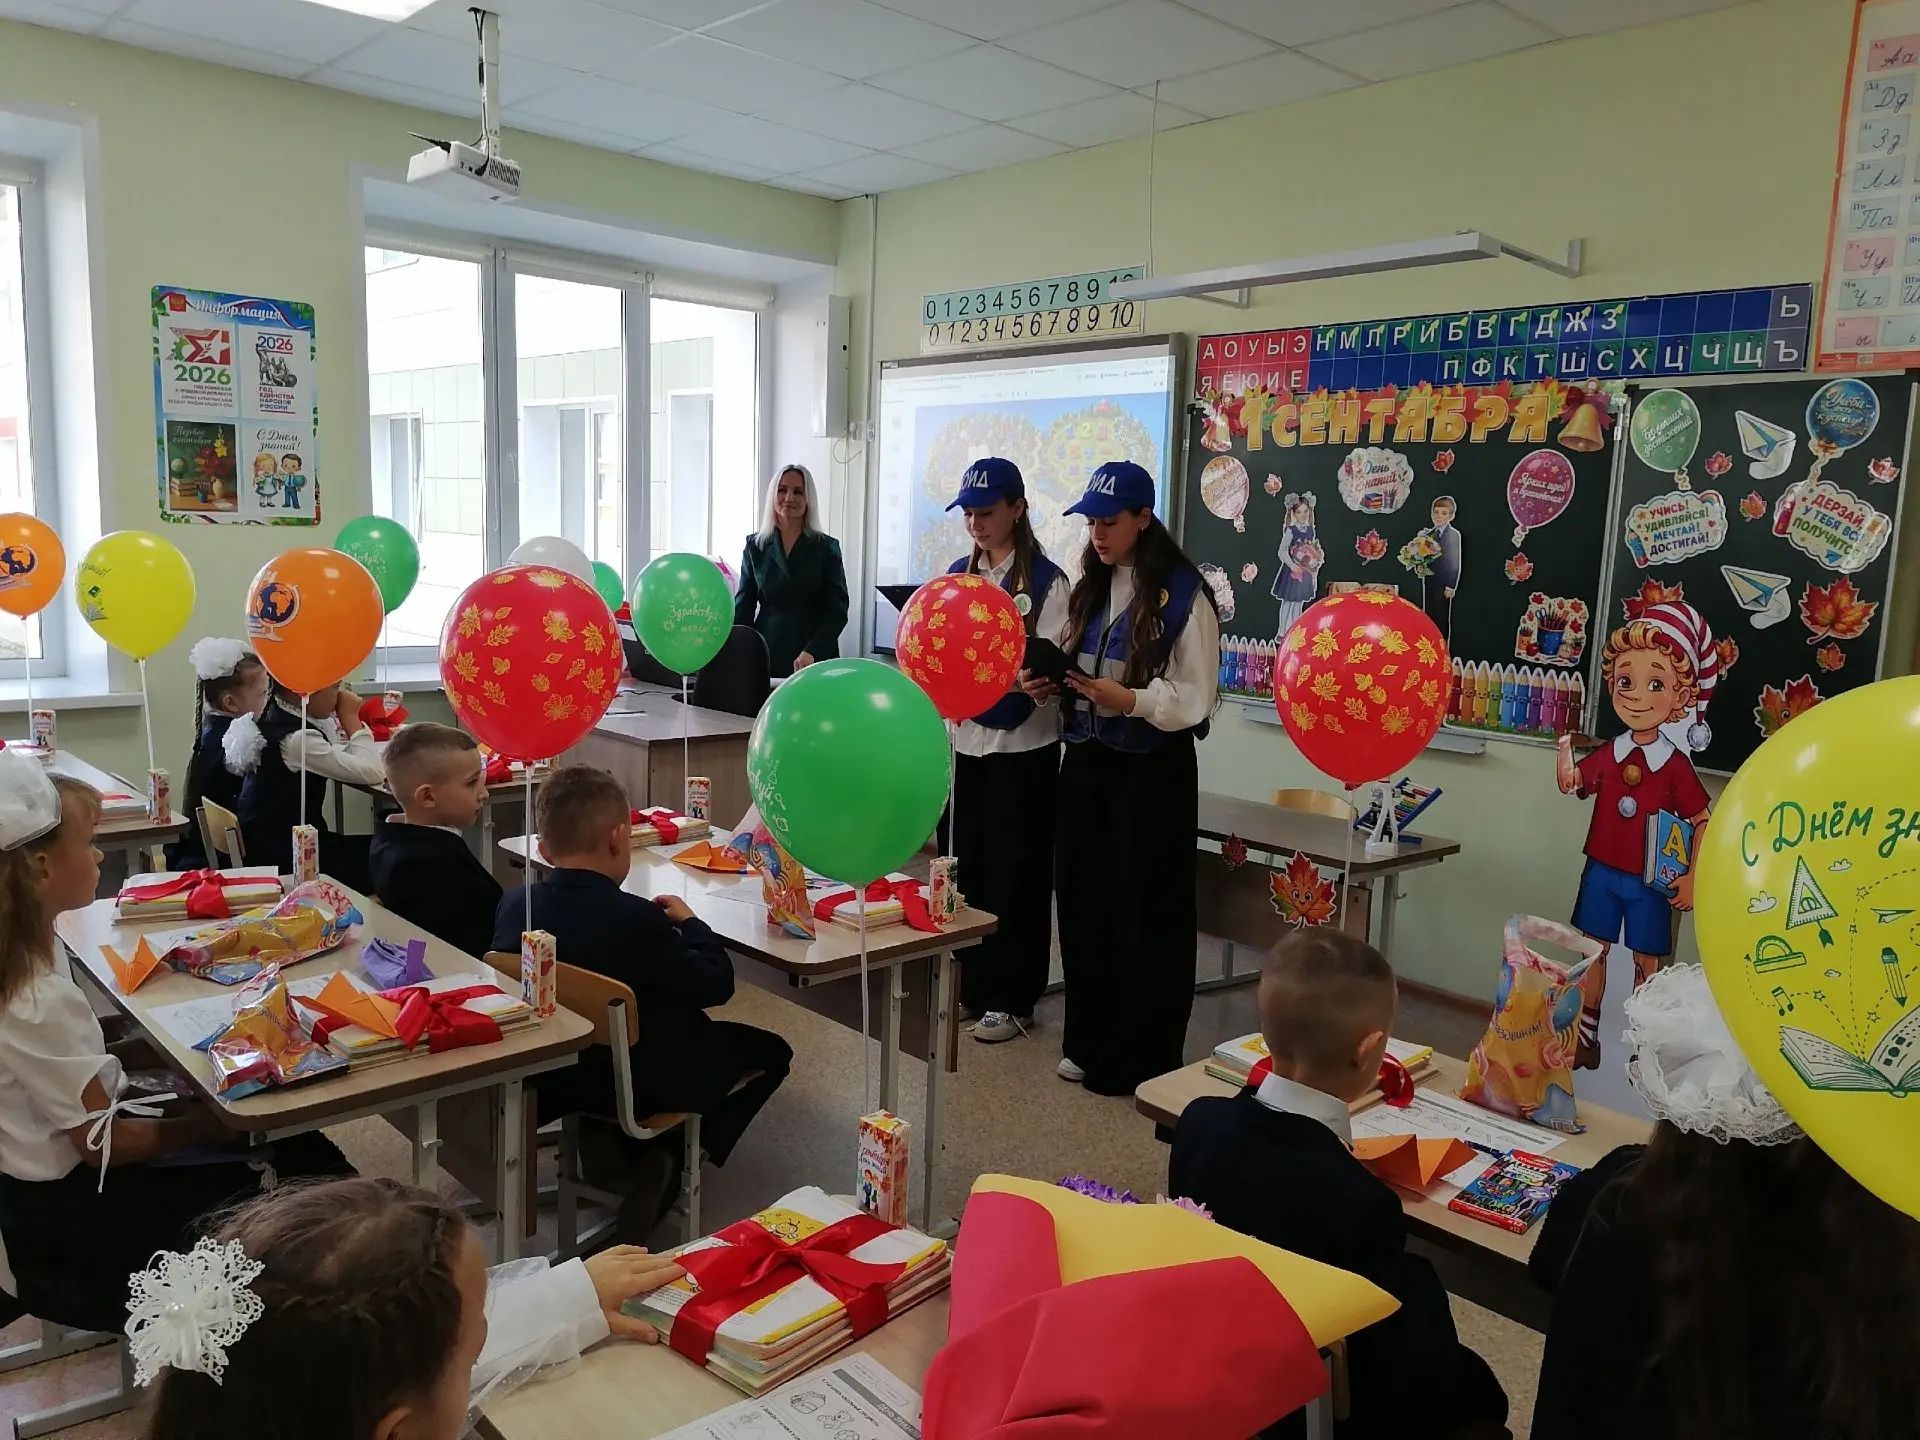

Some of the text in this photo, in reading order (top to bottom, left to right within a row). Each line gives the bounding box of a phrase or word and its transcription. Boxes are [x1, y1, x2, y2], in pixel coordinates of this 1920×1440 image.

[1856, 208, 1893, 230] Пп
[192, 299, 284, 321] Информация
[926, 279, 1100, 319] 0 1 2 3 4 5 6 7 8 9
[929, 301, 1134, 346] 0 1 2 3 4 5 6 7 8 9 10
[1202, 343, 1215, 360] А
[1224, 341, 1237, 358] О
[1248, 339, 1261, 357] У
[1266, 337, 1284, 356] Ы
[1293, 335, 1306, 353] Э
[1316, 333, 1330, 351] Н
[1339, 331, 1356, 349] М
[1365, 330, 1380, 348] Л
[1394, 326, 1407, 346] Р
[1448, 321, 1464, 341] Б
[1477, 319, 1492, 338] В
[1534, 314, 1553, 339] Д
[1565, 312, 1588, 333] Ж
[1601, 309, 1616, 330] З
[1780, 295, 1800, 318] Ь
[257, 335, 294, 351] 2026
[173, 364, 232, 384] 2026
[1200, 340, 1799, 393] Я Ё Ю И Е П Ф К Т Ш С Х Ц Ч Щ Ъ
[1239, 394, 1550, 451] 1 СЕНТЯБРЯ
[1364, 460, 1390, 475] День
[1644, 507, 1710, 533] УДИВЛЯЙСЯ!
[1649, 500, 1689, 519] УЧИСЬ!
[1814, 510, 1840, 532] ТЕБЯ
[1649, 532, 1710, 558] ДОСТИГАЙ!
[1653, 522, 1700, 543] МЕЧТАЙ!
[1661, 822, 1690, 867] А
[1741, 821, 1759, 867] С
[1768, 800, 1874, 853] Днём
